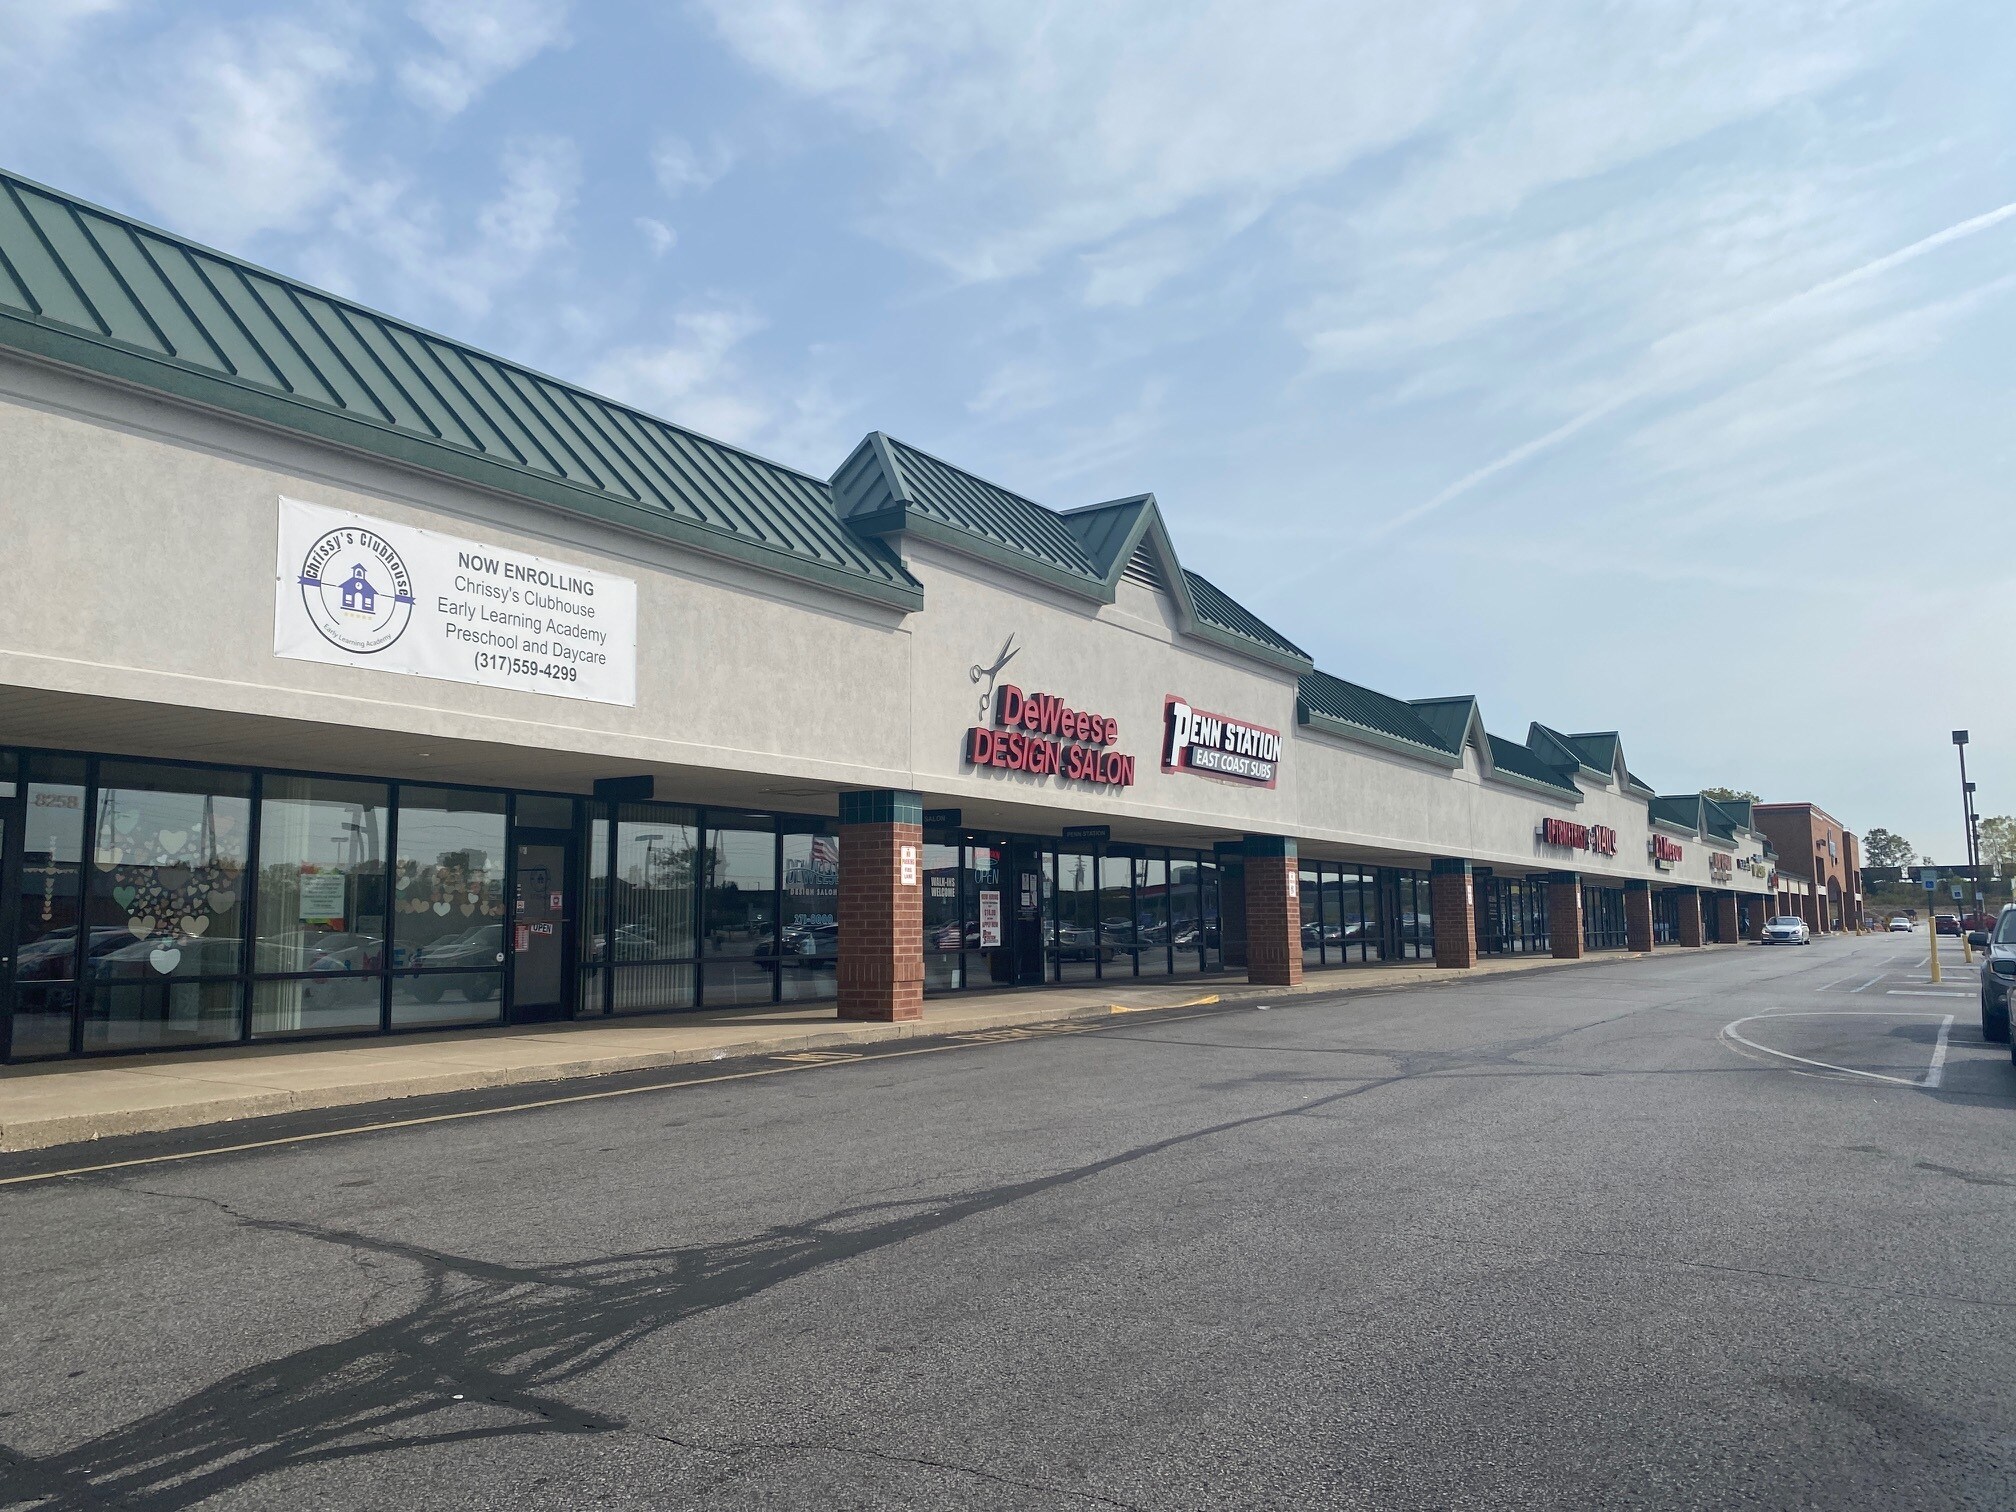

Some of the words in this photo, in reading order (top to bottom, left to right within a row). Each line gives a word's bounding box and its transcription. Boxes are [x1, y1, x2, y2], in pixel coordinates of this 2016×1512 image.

[306, 531, 353, 579] Chrissy's
[360, 533, 408, 596] Clubhouse
[458, 552, 499, 575] NOW
[504, 563, 594, 596] ENROLLING
[454, 575, 520, 603] Chrissy's
[524, 591, 595, 618] Clubhouse
[323, 623, 341, 639] Early
[339, 631, 365, 648] Learning
[366, 633, 392, 648] Academy
[438, 597, 476, 622] Early
[481, 605, 542, 634] Learning
[546, 619, 607, 646] Academy
[446, 623, 518, 650] Preschool
[522, 639, 548, 655] and
[552, 643, 606, 665] Daycare
[474, 652, 577, 682] (317)559-4299
[1000, 684, 1118, 746] DeWeese
[1170, 701, 1221, 766] PENN
[1224, 723, 1283, 762] STATION
[970, 727, 1061, 775] DESIGN
[1066, 744, 1135, 786] SALON
[1196, 749, 1218, 767] EAST
[1220, 755, 1249, 775] COAST
[1250, 762, 1272, 780] SUBS
[790, 888, 814, 896] DESIGN
[816, 888, 838, 896] SALON
[931, 887, 955, 897] WELCOME
[533, 923, 552, 933] OPEN
